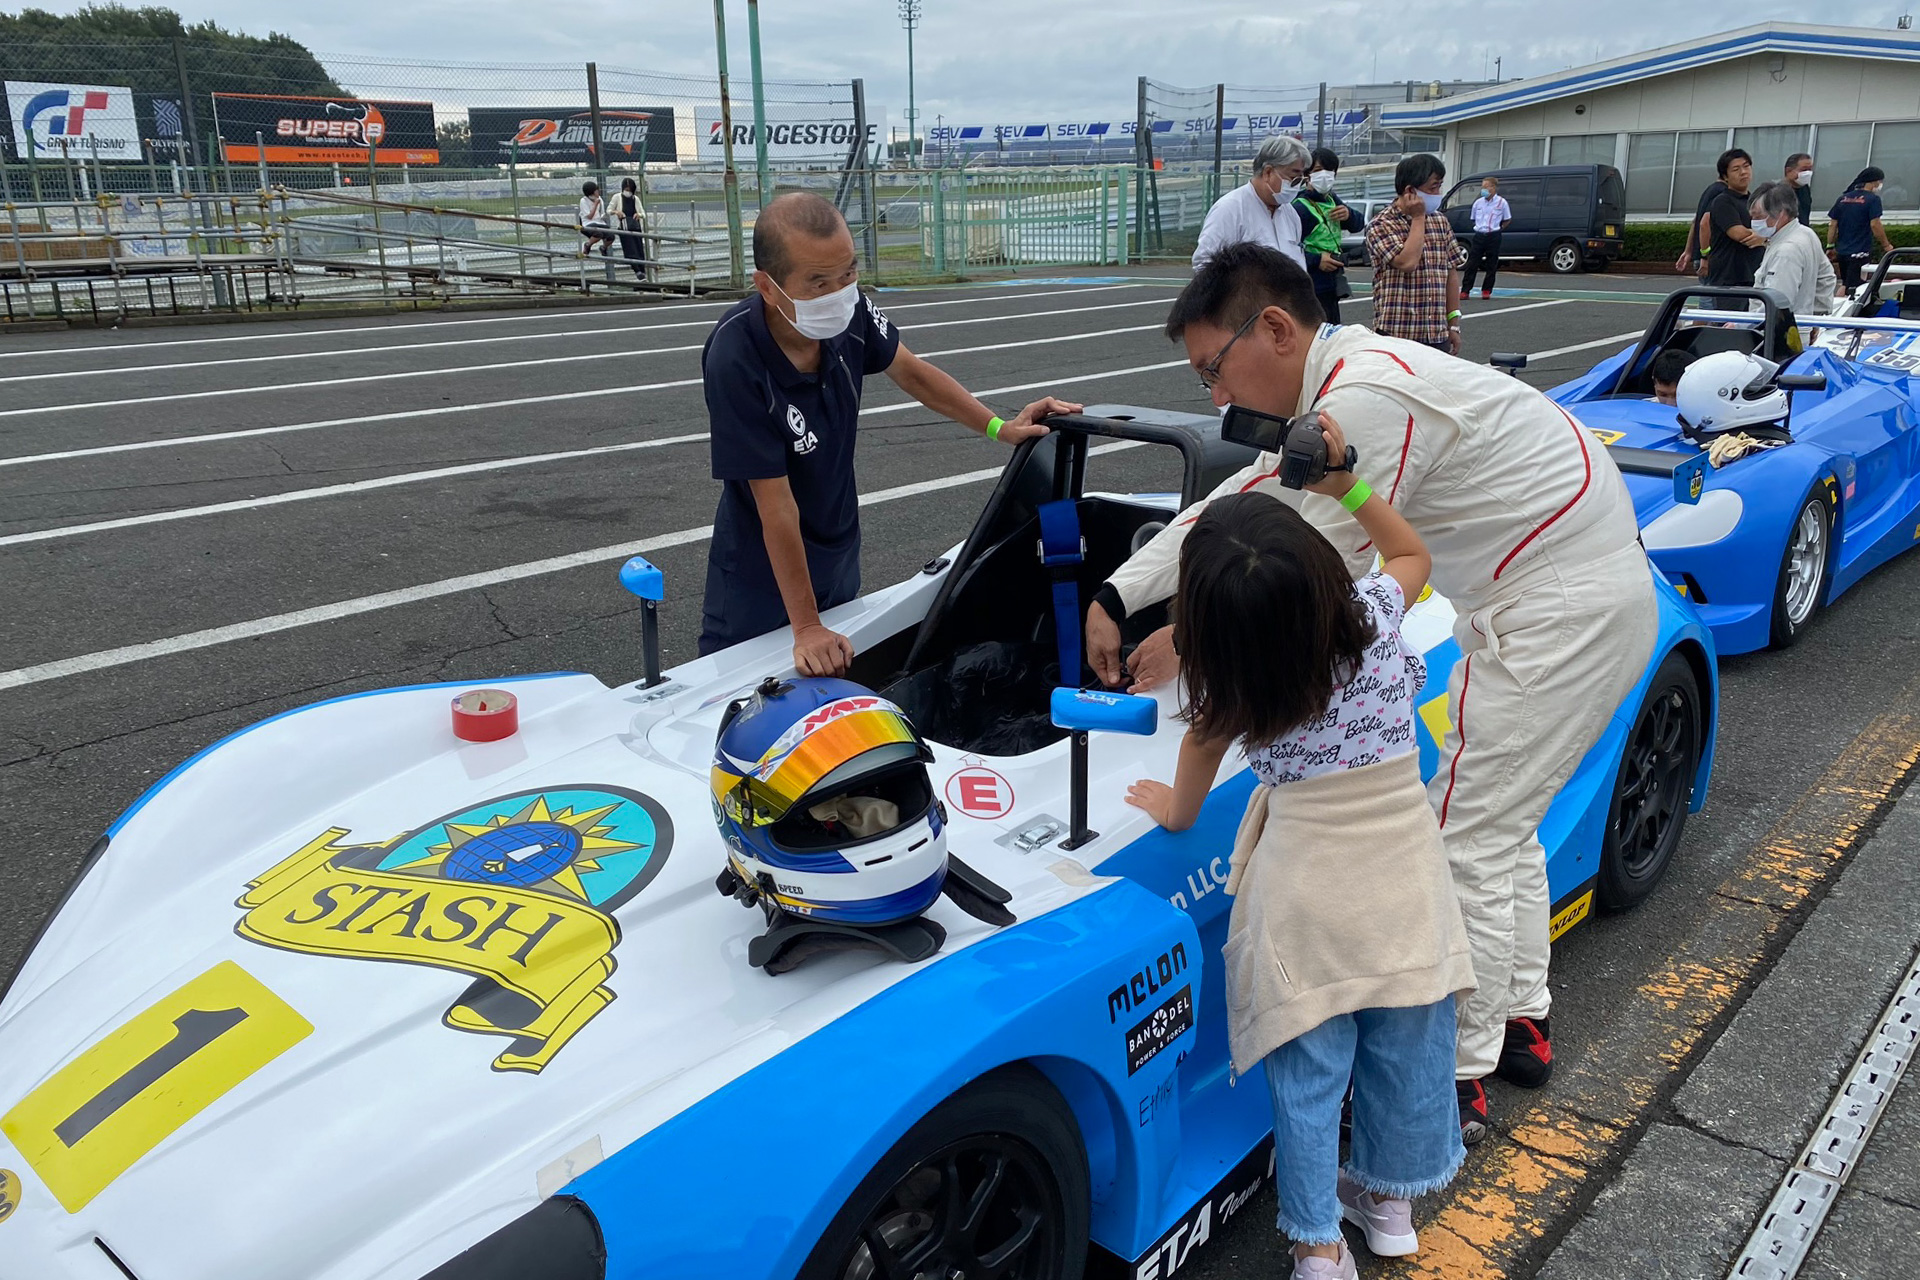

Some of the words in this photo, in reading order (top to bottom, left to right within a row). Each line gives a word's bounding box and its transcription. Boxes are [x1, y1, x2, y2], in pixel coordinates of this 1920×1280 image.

[276, 119, 359, 137] SUPER
[550, 119, 648, 145] Lanuage
[930, 127, 960, 139] SEV
[993, 126, 1025, 138] SEV
[1057, 124, 1088, 136] SEV
[1120, 121, 1144, 134] SE
[1184, 119, 1216, 132] SEV
[1248, 116, 1280, 129] SEV
[793, 431, 819, 452] ETA
[1341, 675, 1382, 702] Barbie
[1377, 677, 1406, 704] Barbie
[1344, 714, 1386, 740] Barbie
[1378, 719, 1411, 745] Barbie
[1268, 741, 1308, 760] Barbie
[957, 775, 1002, 812] E
[777, 884, 804, 895] SPEED
[1186, 856, 1228, 901] LLC
[284, 882, 566, 969] STASH
[1549, 902, 1586, 936] UNLOP
[1134, 1047, 1157, 1069] POWER
[1159, 1040, 1165, 1049] &
[1166, 1022, 1187, 1043] FORCE
[53, 1006, 250, 1148] 1
[1137, 1200, 1213, 1280] ETA
